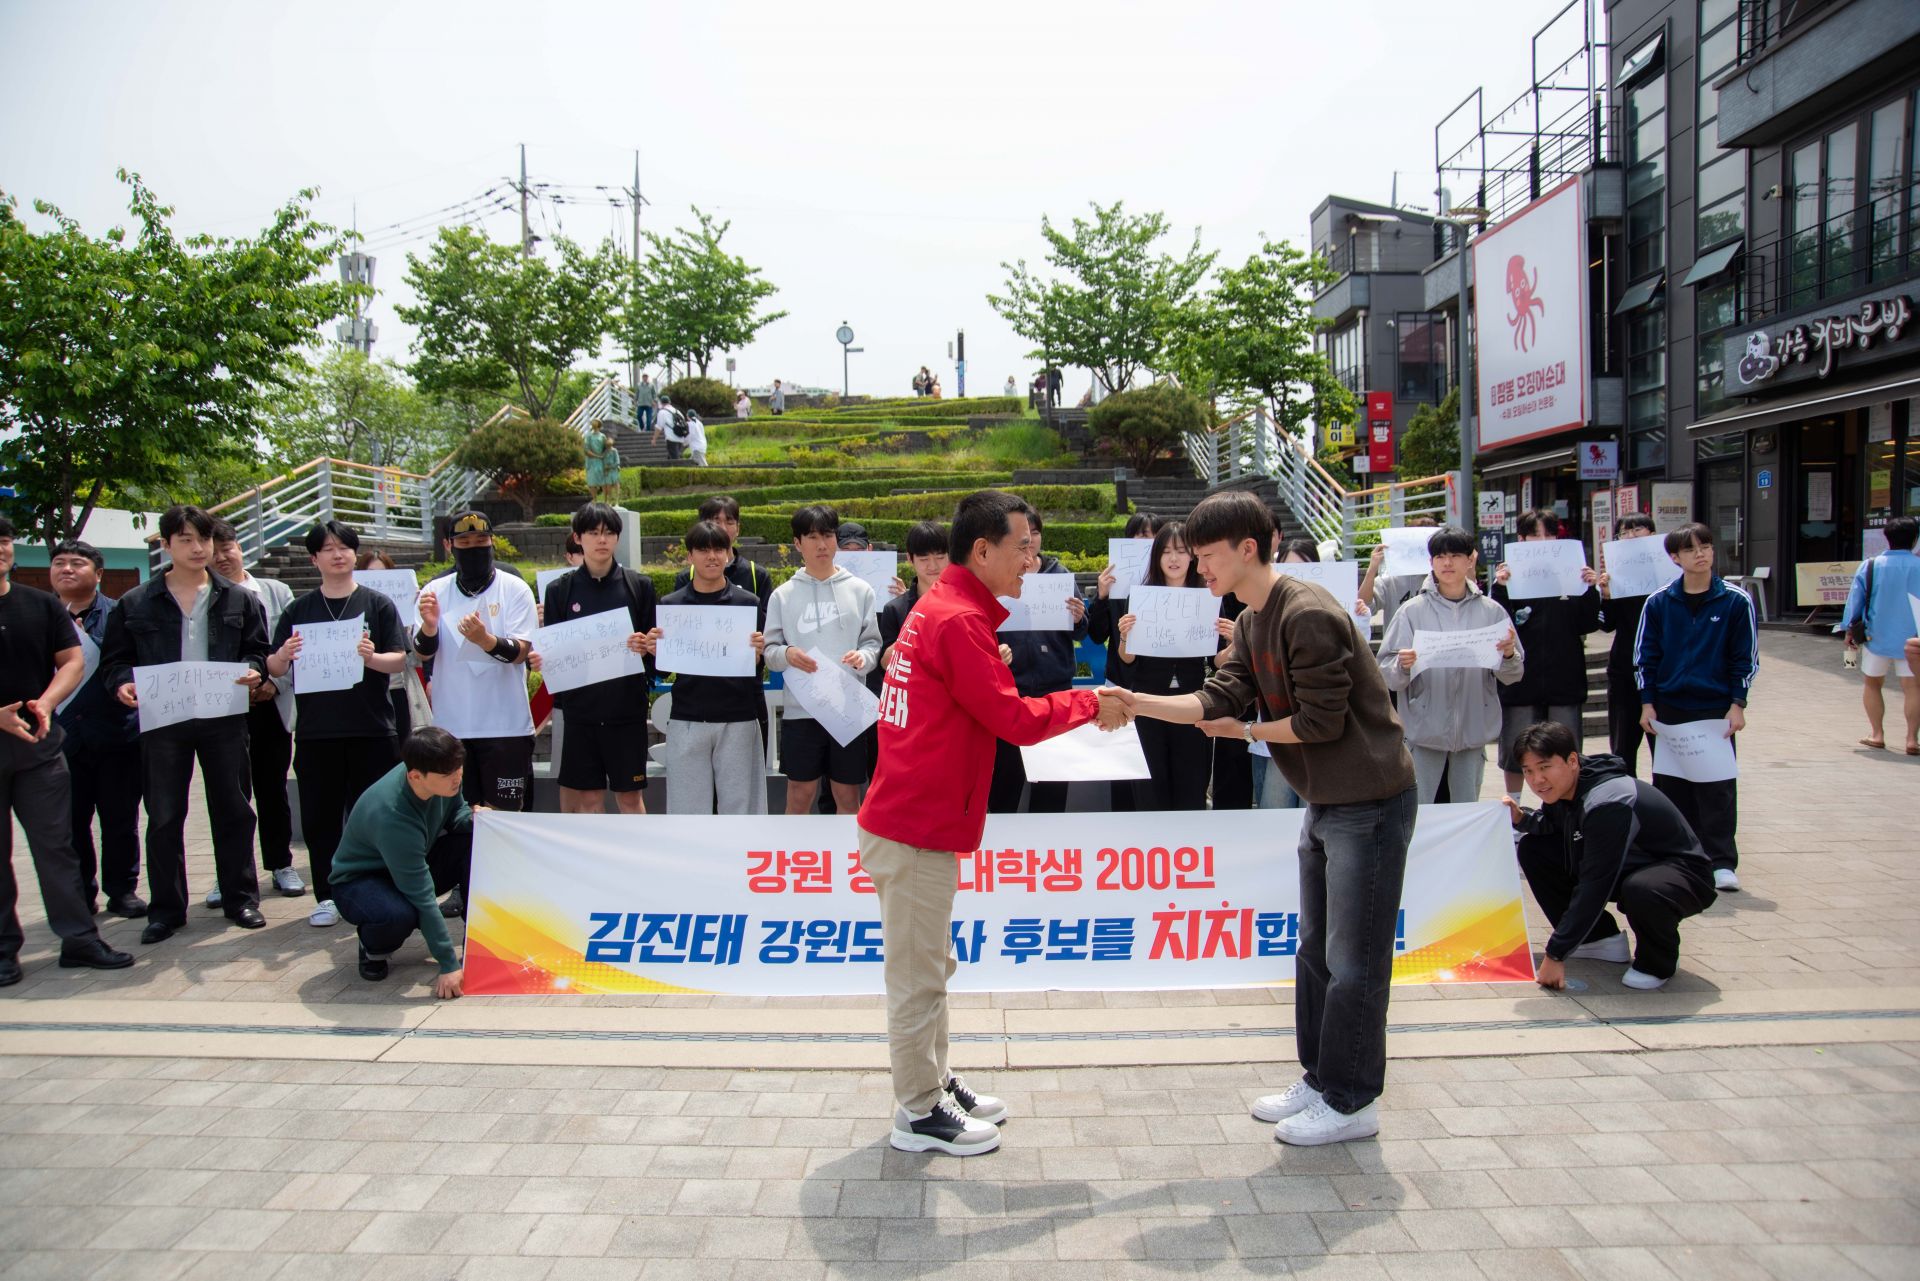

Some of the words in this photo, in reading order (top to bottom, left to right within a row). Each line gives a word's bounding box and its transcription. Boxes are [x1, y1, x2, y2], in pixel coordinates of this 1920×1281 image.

[1776, 326, 1808, 364] 강릉
[1517, 360, 1566, 398] 오징어순대
[804, 602, 840, 619] NIKE
[1136, 590, 1202, 624] 김진태
[539, 625, 591, 651] 도지사님
[746, 850, 833, 894] 강원
[957, 848, 1083, 893] 대학생
[1096, 846, 1215, 890] 200인
[585, 912, 749, 966] 김진태
[758, 918, 987, 964] 강원도사
[1000, 916, 1136, 964] 후보를
